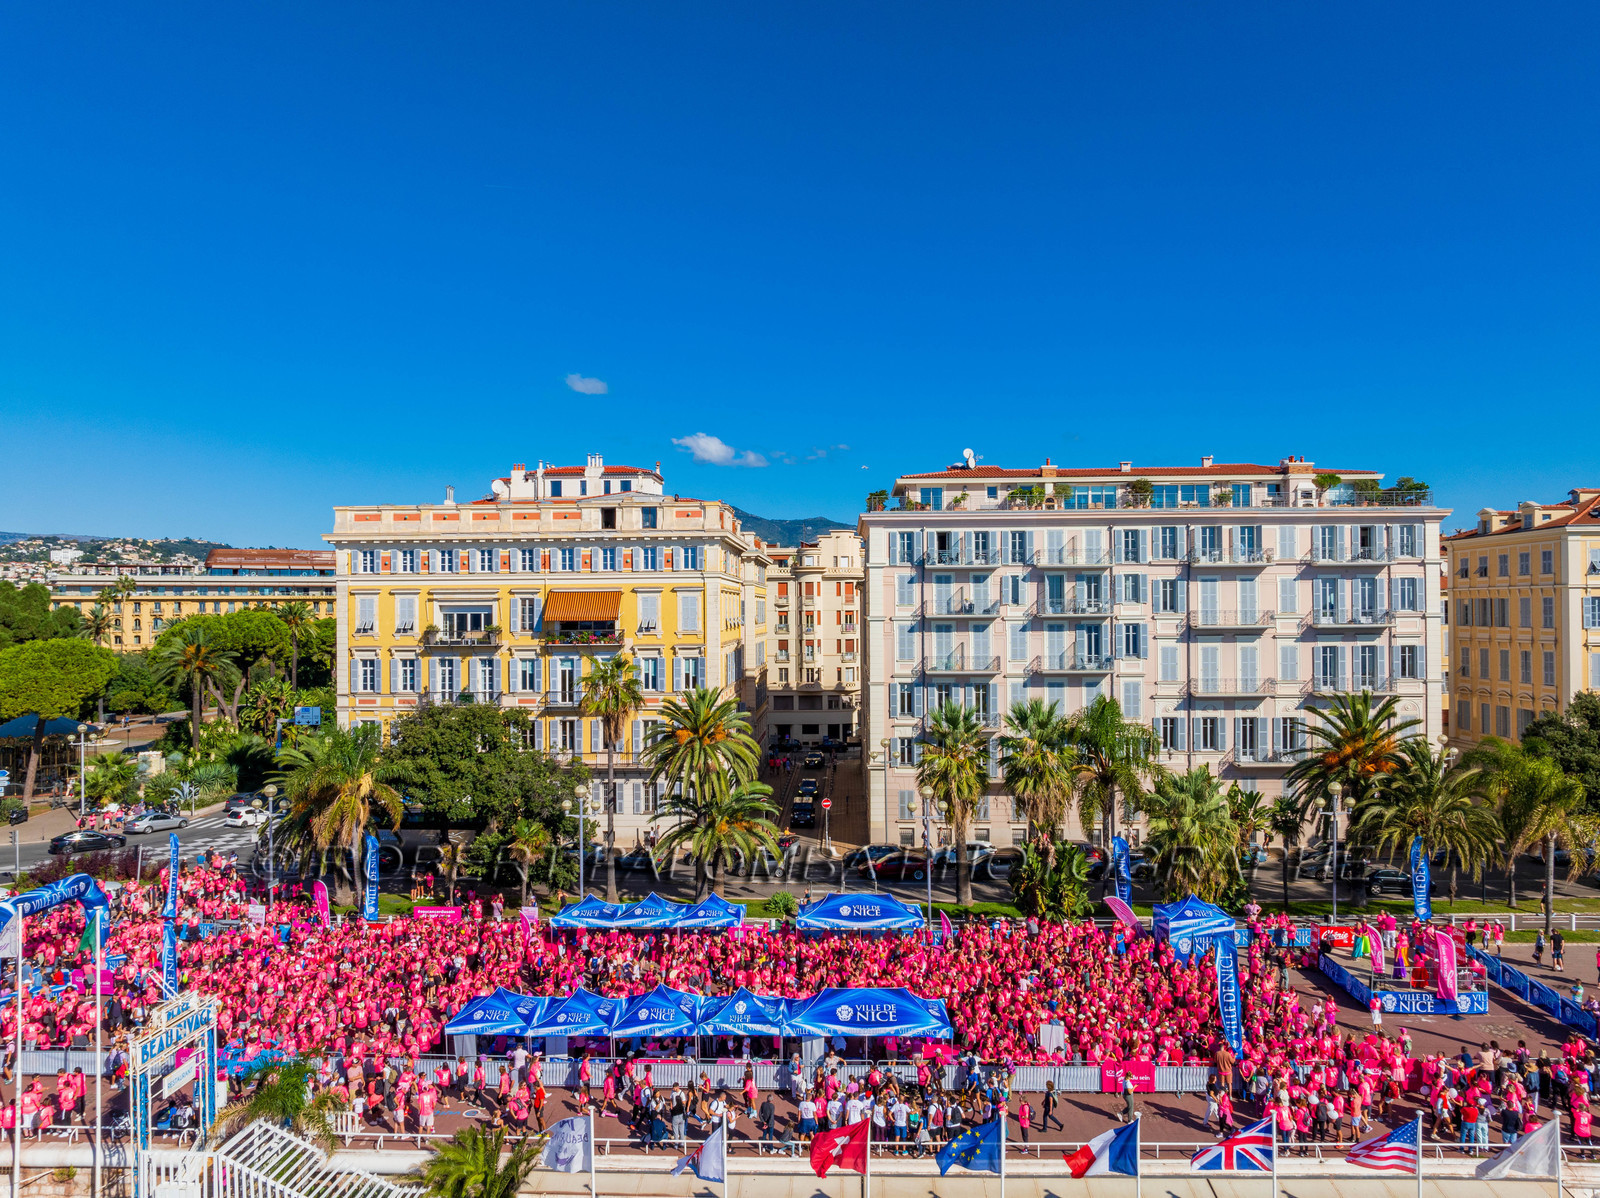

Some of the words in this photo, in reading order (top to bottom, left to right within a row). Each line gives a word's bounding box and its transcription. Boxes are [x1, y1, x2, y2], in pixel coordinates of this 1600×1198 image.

[370, 870, 377, 882] DE
[1416, 870, 1426, 882] DE
[32, 893, 51, 910] VILLE
[52, 892, 61, 904] DE
[62, 885, 78, 900] NICE
[368, 883, 376, 905] VILLE
[1416, 884, 1426, 906] VILLE
[1220, 953, 1234, 983] NICE
[1223, 986, 1236, 1002] DE
[856, 1011, 897, 1022] NICE
[1400, 1002, 1434, 1013] NICE
[1224, 1005, 1238, 1036] VILLE
[142, 1029, 173, 1064] BEAU
